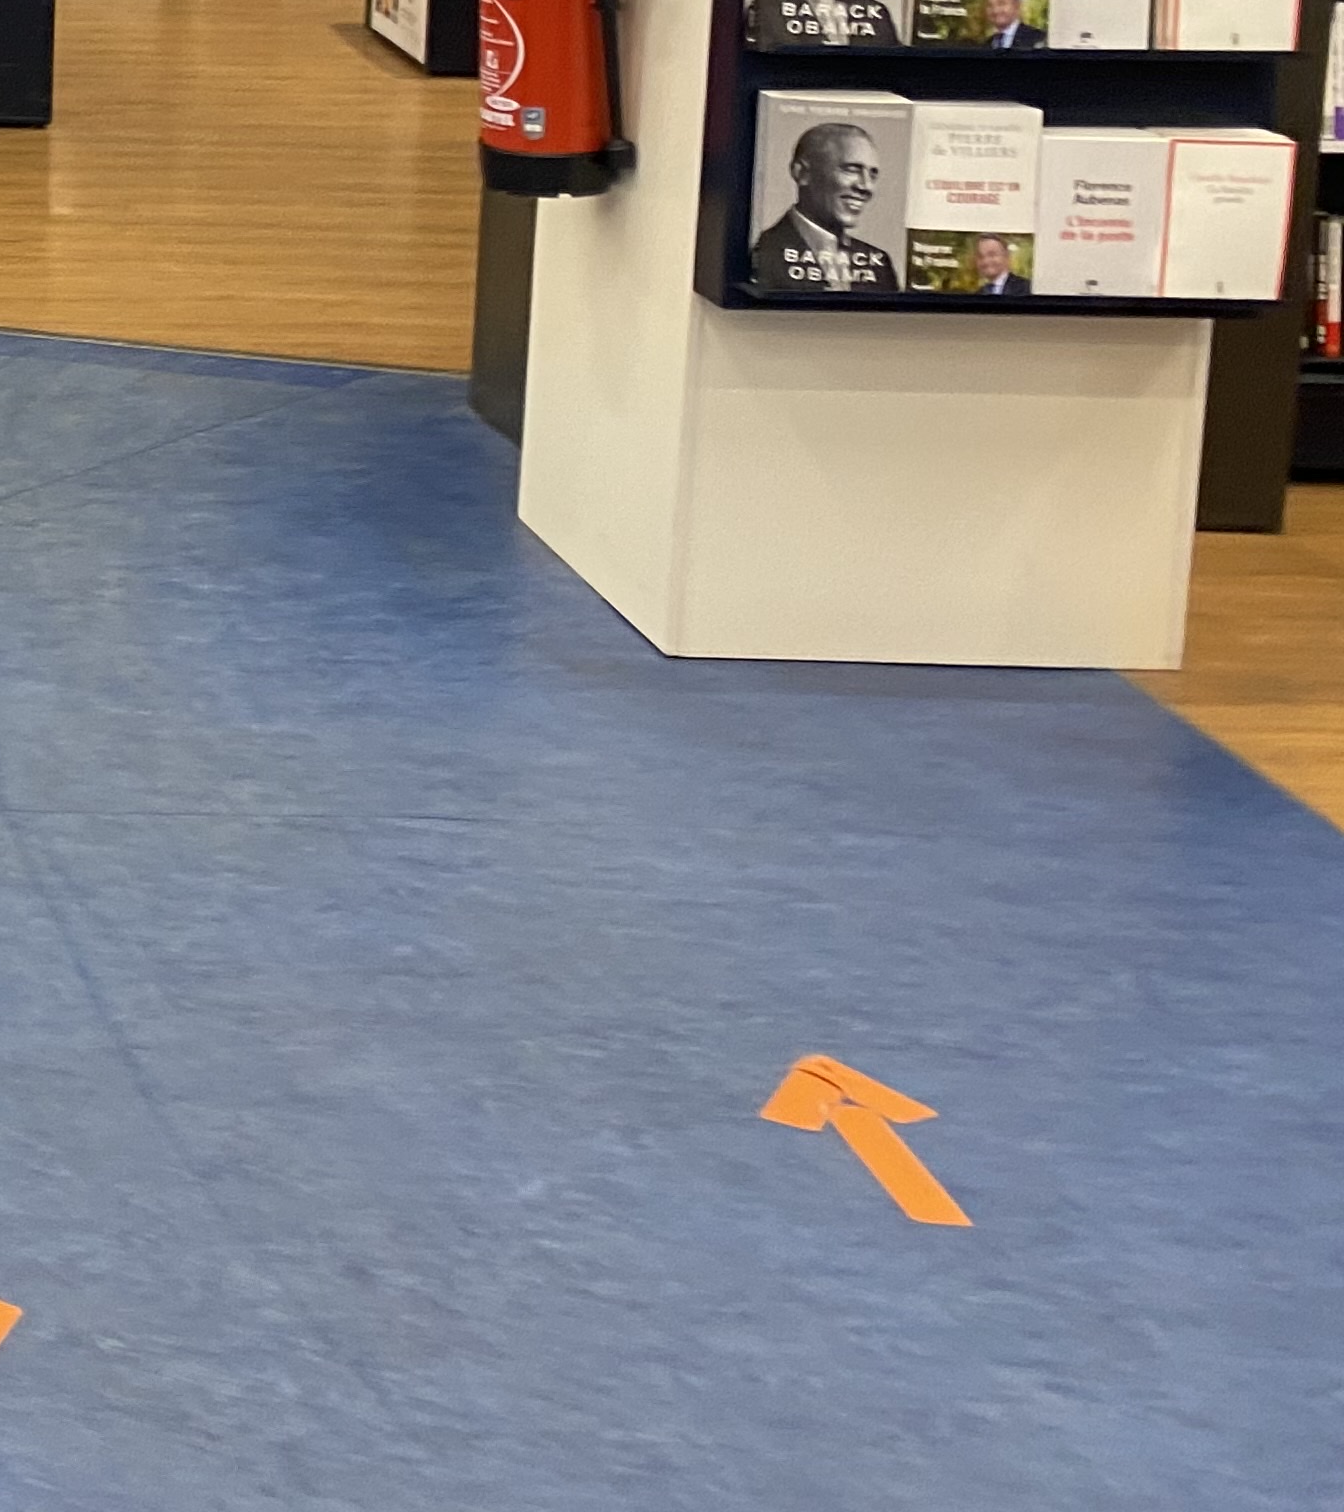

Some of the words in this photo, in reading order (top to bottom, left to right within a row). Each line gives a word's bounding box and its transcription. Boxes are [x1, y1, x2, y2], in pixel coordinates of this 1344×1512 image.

[781, 2, 883, 19] BARACK
[787, 21, 876, 36] OBAMA
[784, 248, 886, 267] BARACK
[788, 266, 876, 282] OBAMA
